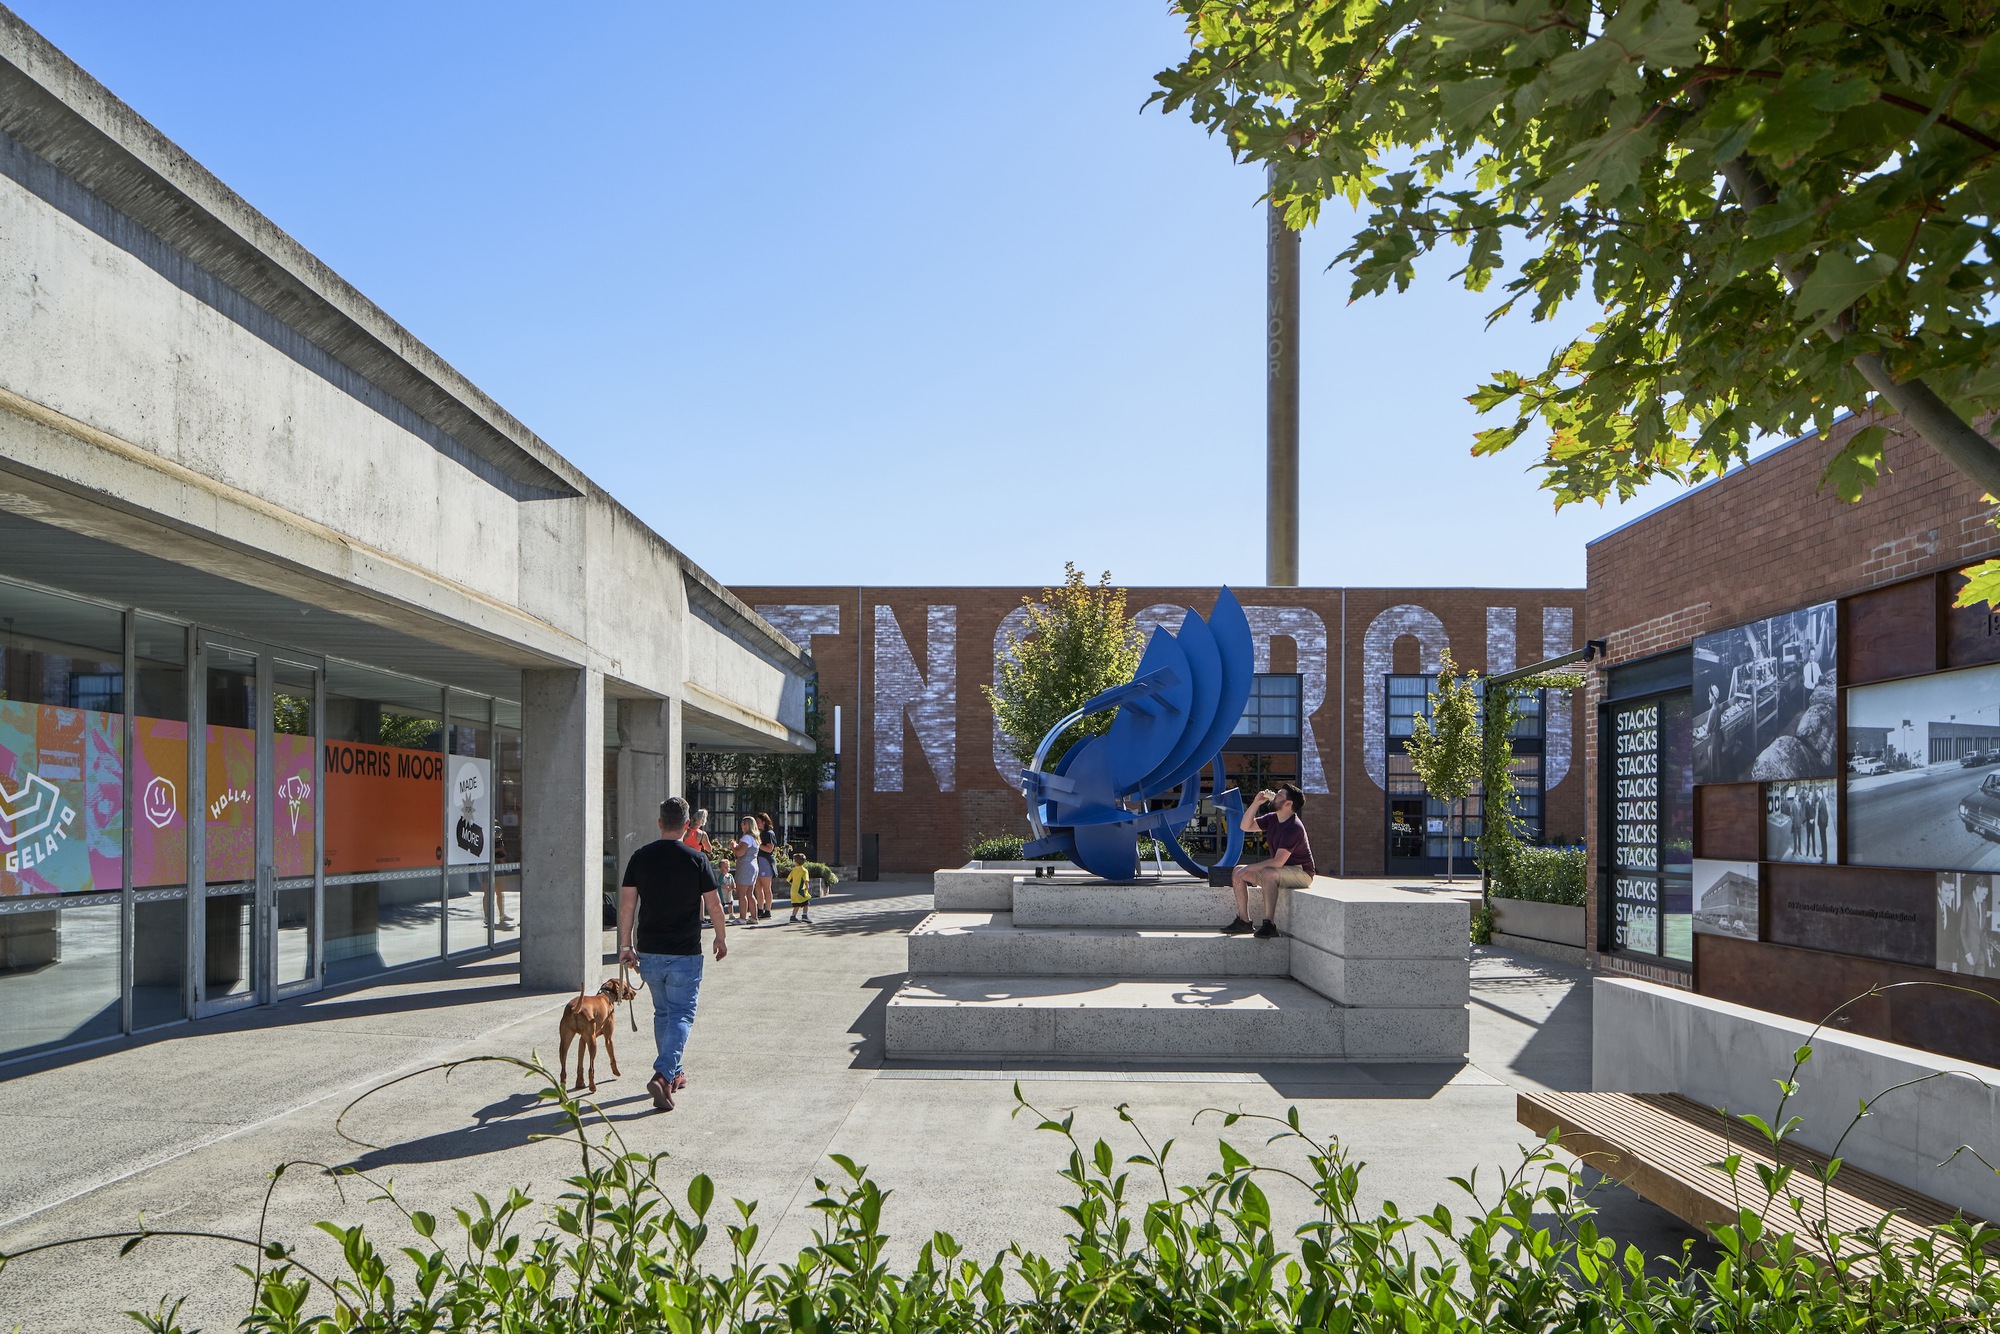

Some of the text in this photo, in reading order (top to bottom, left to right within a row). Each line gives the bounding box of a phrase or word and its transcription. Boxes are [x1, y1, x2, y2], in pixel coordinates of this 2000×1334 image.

[1268, 298, 1284, 380] MOOR
[1617, 706, 1658, 732] STACKS
[1617, 730, 1658, 754] STACKS
[325, 745, 443, 781] MORRIS MOOR
[1617, 753, 1658, 776] STACKS
[459, 776, 478, 793] MADE
[1617, 777, 1658, 799] STACKS
[210, 788, 251, 819] HOLLA!
[1617, 800, 1658, 821] STACKS
[6, 805, 76, 873] GELATO
[461, 827, 479, 847] MORE
[1617, 824, 1658, 844] STACKS
[1617, 846, 1658, 867] STACKS
[1616, 879, 1658, 902] STACKS
[1616, 902, 1657, 925] STACKS
